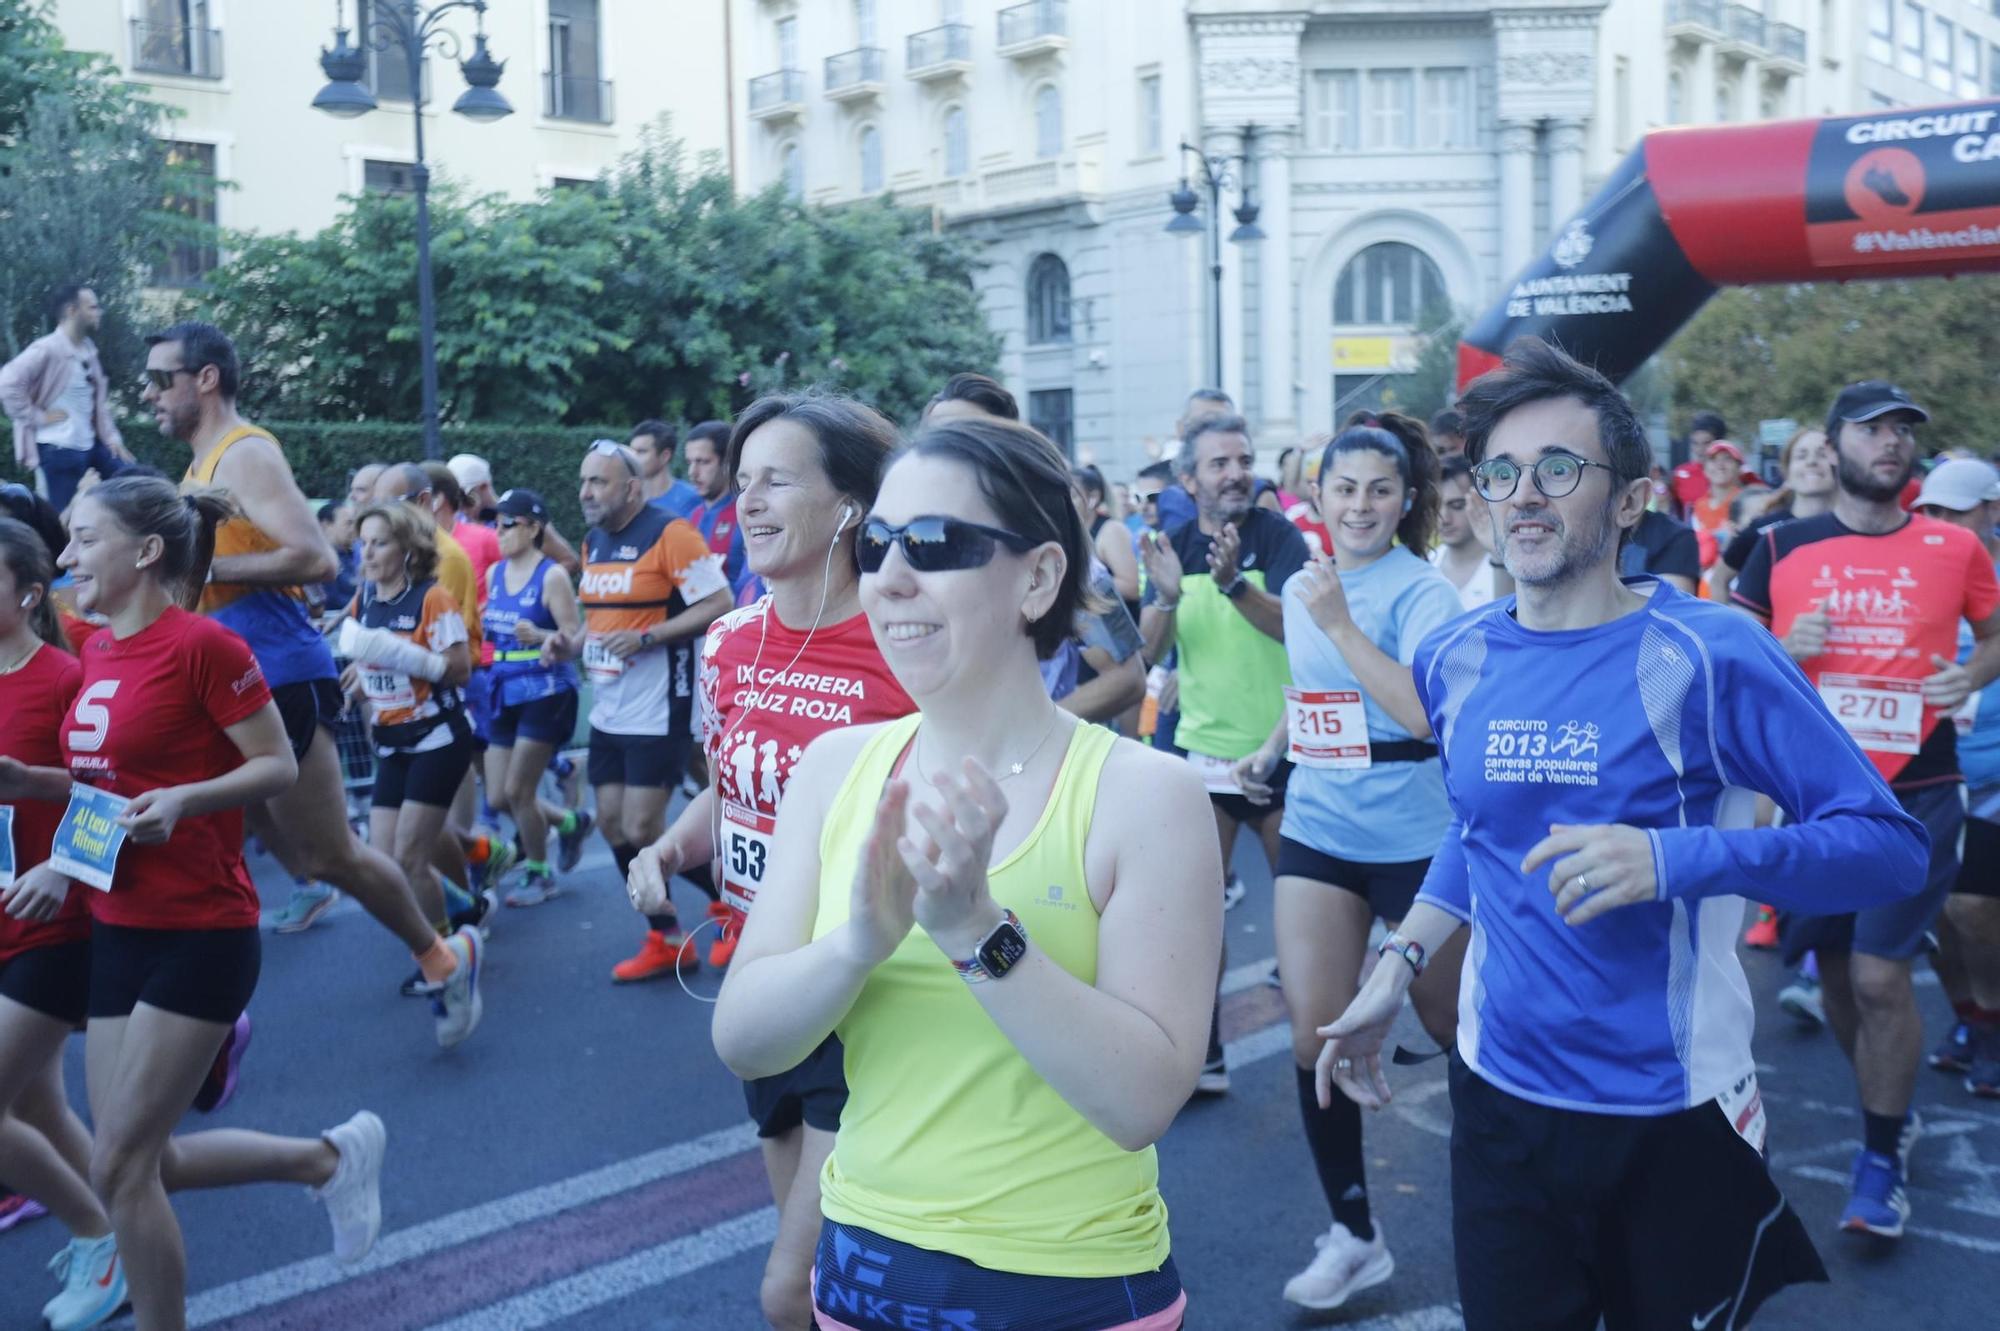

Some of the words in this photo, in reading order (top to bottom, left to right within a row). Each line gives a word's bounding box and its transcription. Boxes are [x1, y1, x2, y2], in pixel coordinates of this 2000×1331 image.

[1846, 110, 1997, 144] CIRCUIT
[736, 665, 754, 684] IX
[757, 668, 865, 700] CARRERA
[734, 690, 788, 713] CRUZ
[789, 696, 852, 724] ROJA
[1839, 693, 1899, 720] 270
[1496, 720, 1548, 732] CIRCUITO
[1484, 733, 1548, 757] 2013
[1484, 757, 1532, 769] carreras
[1534, 758, 1598, 772] populares
[1484, 768, 1525, 783] Ciudad
[1527, 770, 1543, 783] de
[1545, 770, 1598, 786] Valencia
